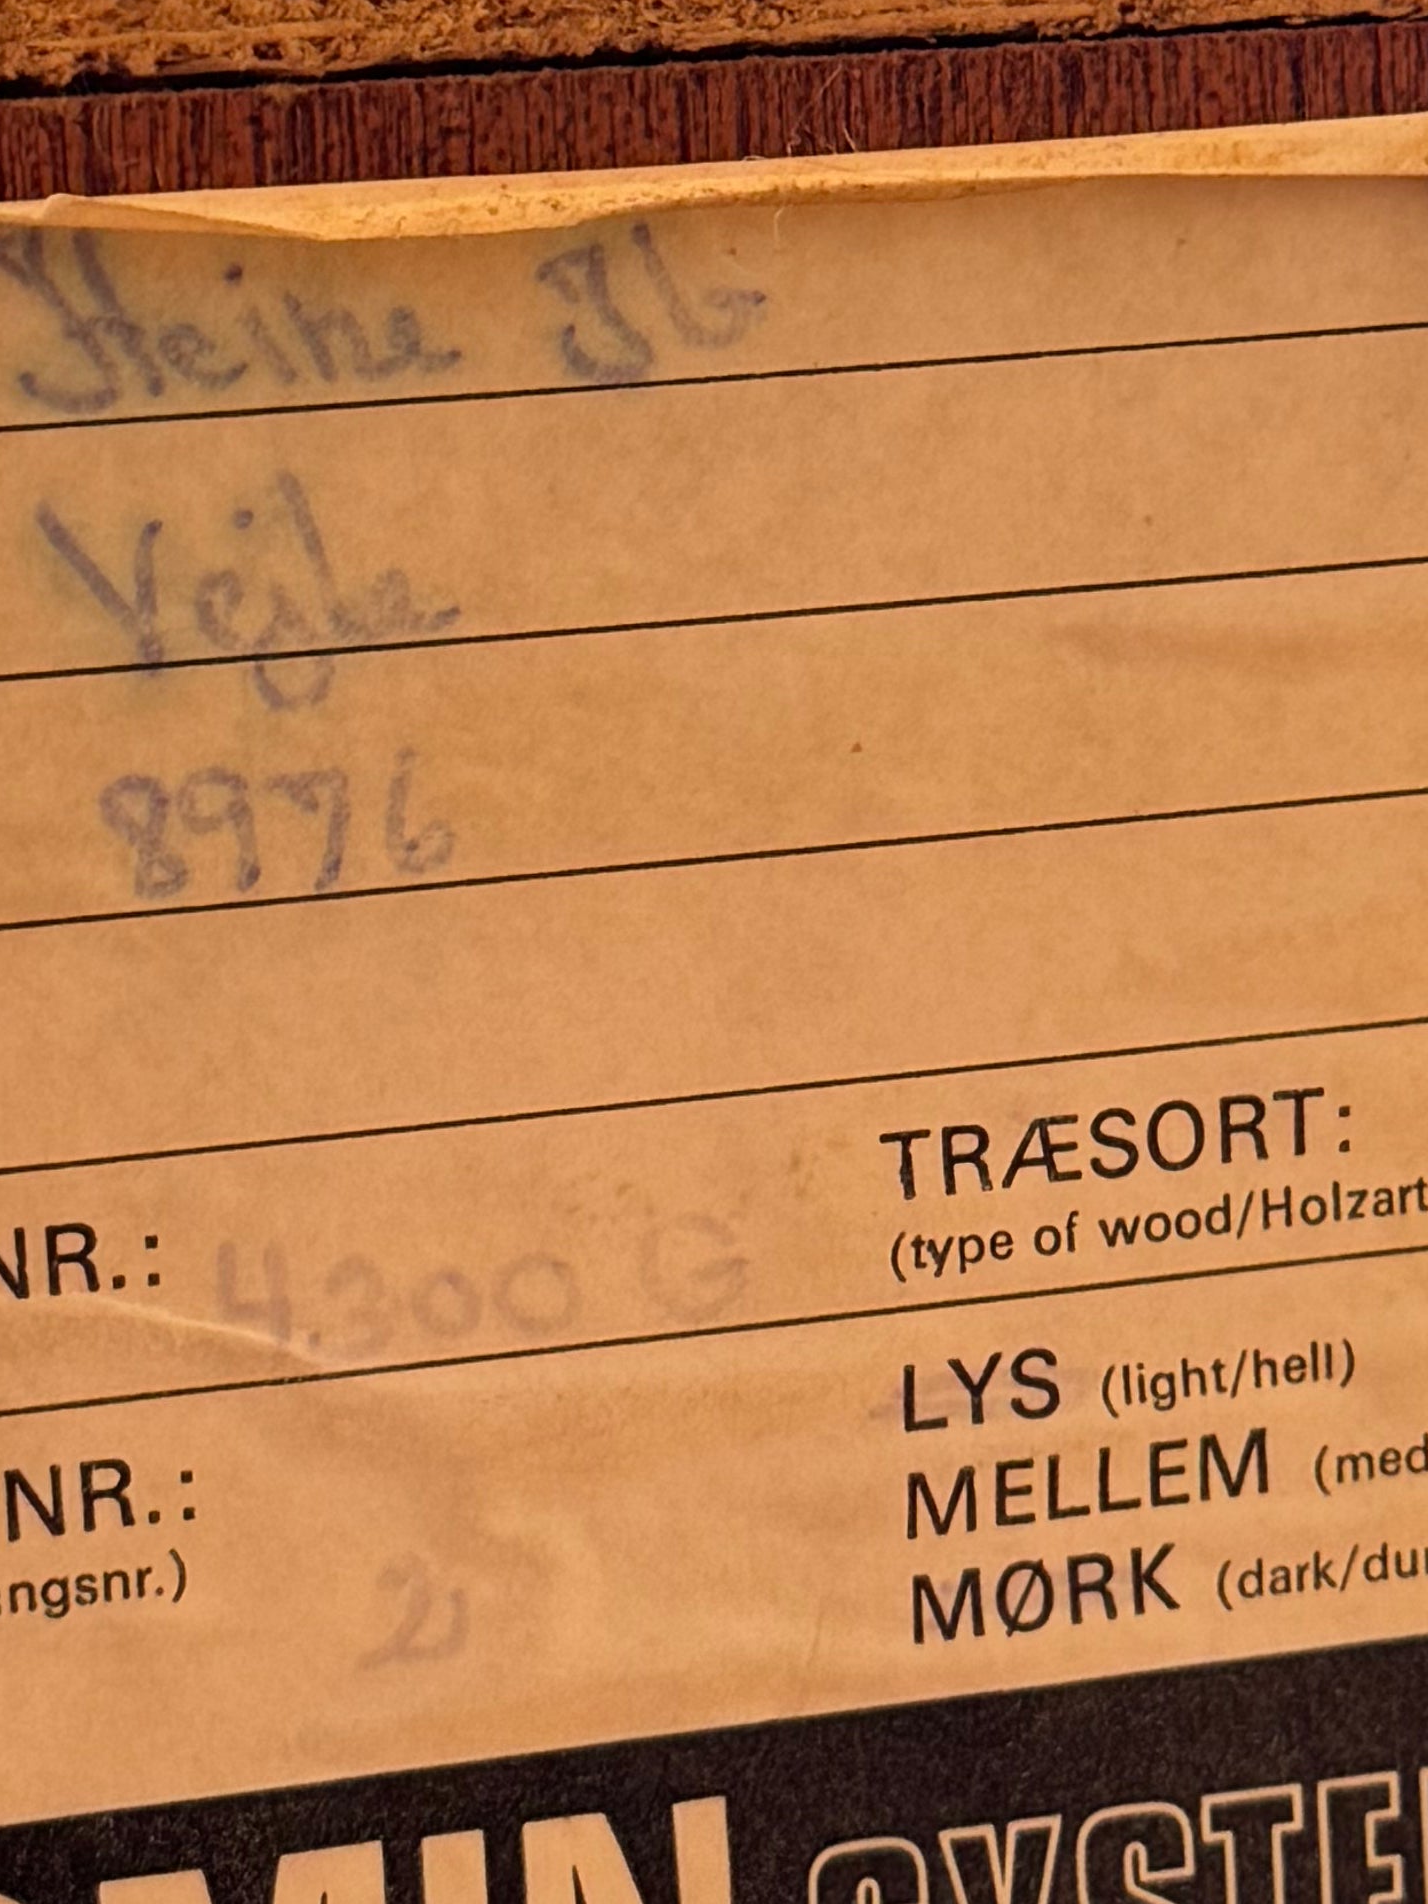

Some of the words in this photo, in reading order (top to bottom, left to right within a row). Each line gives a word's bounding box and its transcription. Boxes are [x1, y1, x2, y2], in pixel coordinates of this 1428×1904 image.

[880, 1087, 1355, 1202] TRÆSORT:
[891, 1230, 1014, 1284] (type
[1033, 1212, 1080, 1258] of
[900, 1348, 1061, 1432] LYS
[1102, 1340, 1356, 1418] (light/hell)
[4, 1456, 198, 1544] NR.:
[905, 1427, 1270, 1540] MELLEM
[910, 1542, 1181, 1646] MØRK
